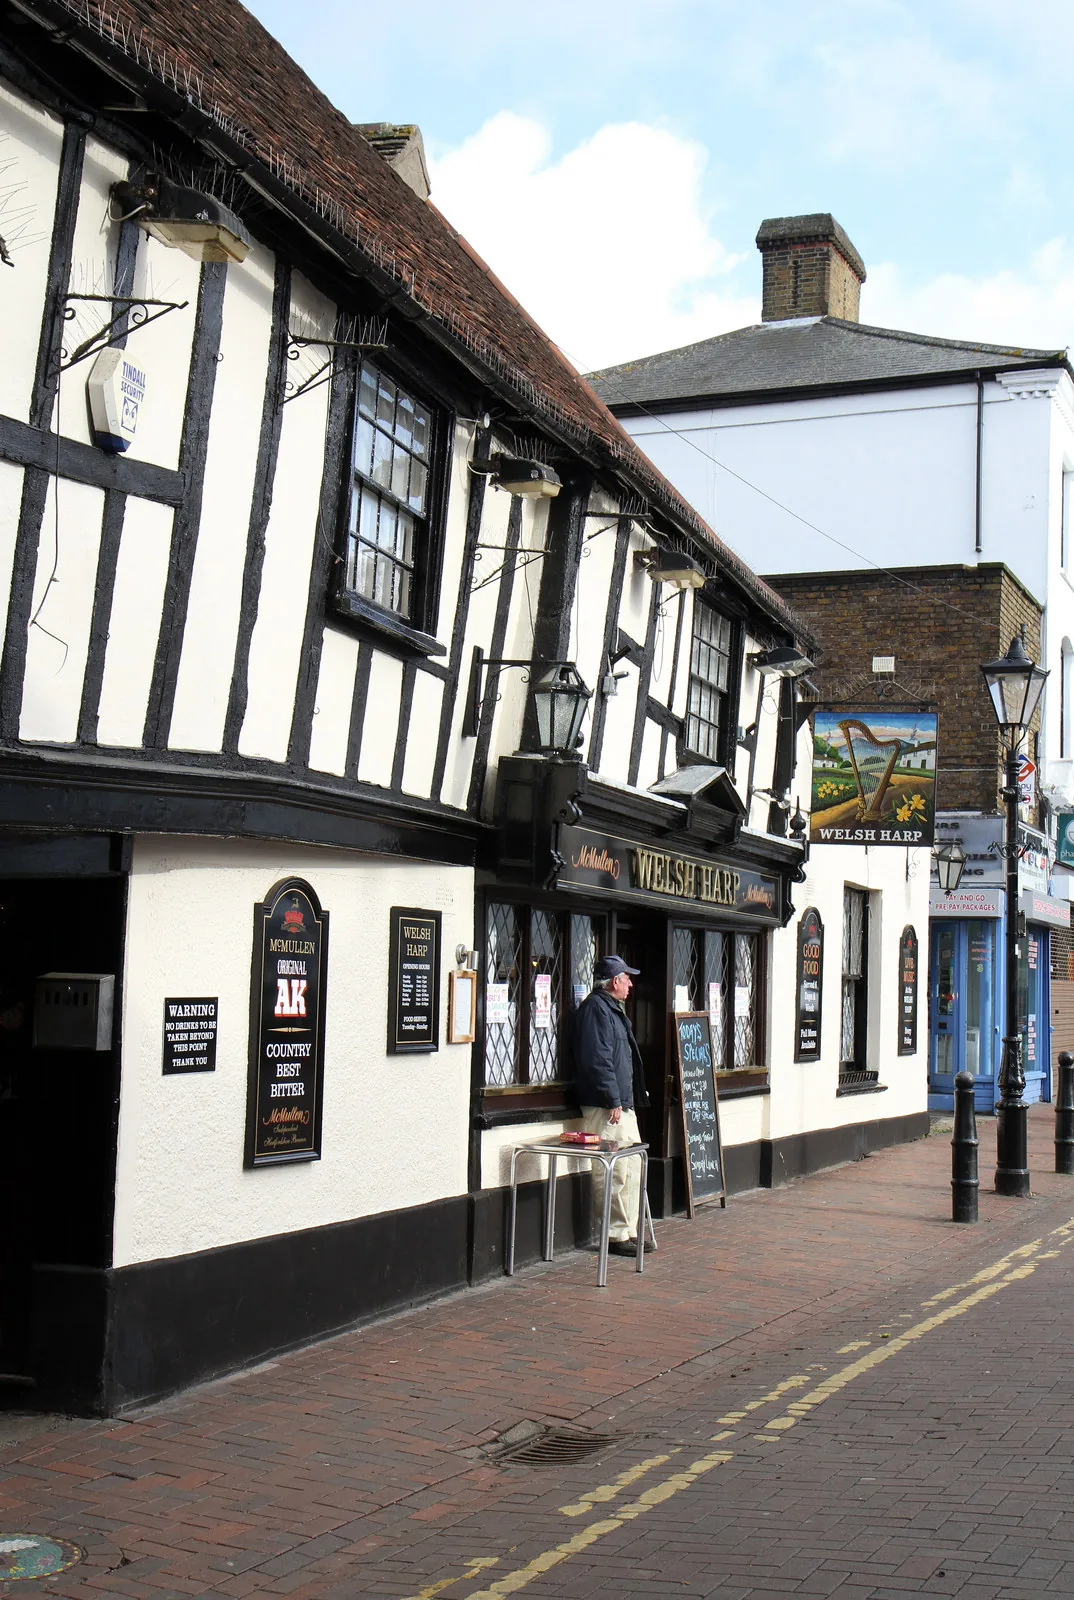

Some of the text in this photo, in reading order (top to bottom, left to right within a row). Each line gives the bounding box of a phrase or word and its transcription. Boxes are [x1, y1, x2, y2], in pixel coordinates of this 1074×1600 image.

[122, 361, 146, 388] TINDALL
[121, 381, 145, 402] SECURITY
[819, 828, 923, 842] WELSH HARP
[571, 844, 620, 881] McMullen
[633, 847, 741, 906] WELSH HARP
[742, 883, 773, 910] McMullen
[962, 903, 996, 911] PACKAGES
[403, 926, 431, 940] WELSH
[269, 938, 315, 955] McMULLEN
[406, 943, 428, 957] HARP
[803, 943, 820, 959] GOOD
[277, 960, 307, 976] ORIGINAL
[803, 960, 819, 975] FOOD
[904, 957, 914, 969] LIVE
[903, 971, 915, 983] MUSIC
[803, 980, 814, 989] Served
[274, 978, 308, 1018] AK
[168, 1004, 216, 1017] WARNING
[805, 1003, 815, 1012] Week
[165, 1021, 217, 1031] NO DRINKS TO BE
[807, 1029, 817, 1037] Menu
[167, 1032, 214, 1042] TAKEN BEYOND
[173, 1043, 208, 1052] THIS POINT
[266, 1043, 312, 1058] COUNTRY
[800, 1040, 816, 1050] Available
[172, 1056, 208, 1067] THANK YOU
[276, 1063, 301, 1078] BEST
[270, 1082, 305, 1098] BITTER
[262, 1106, 310, 1126] McMullen
